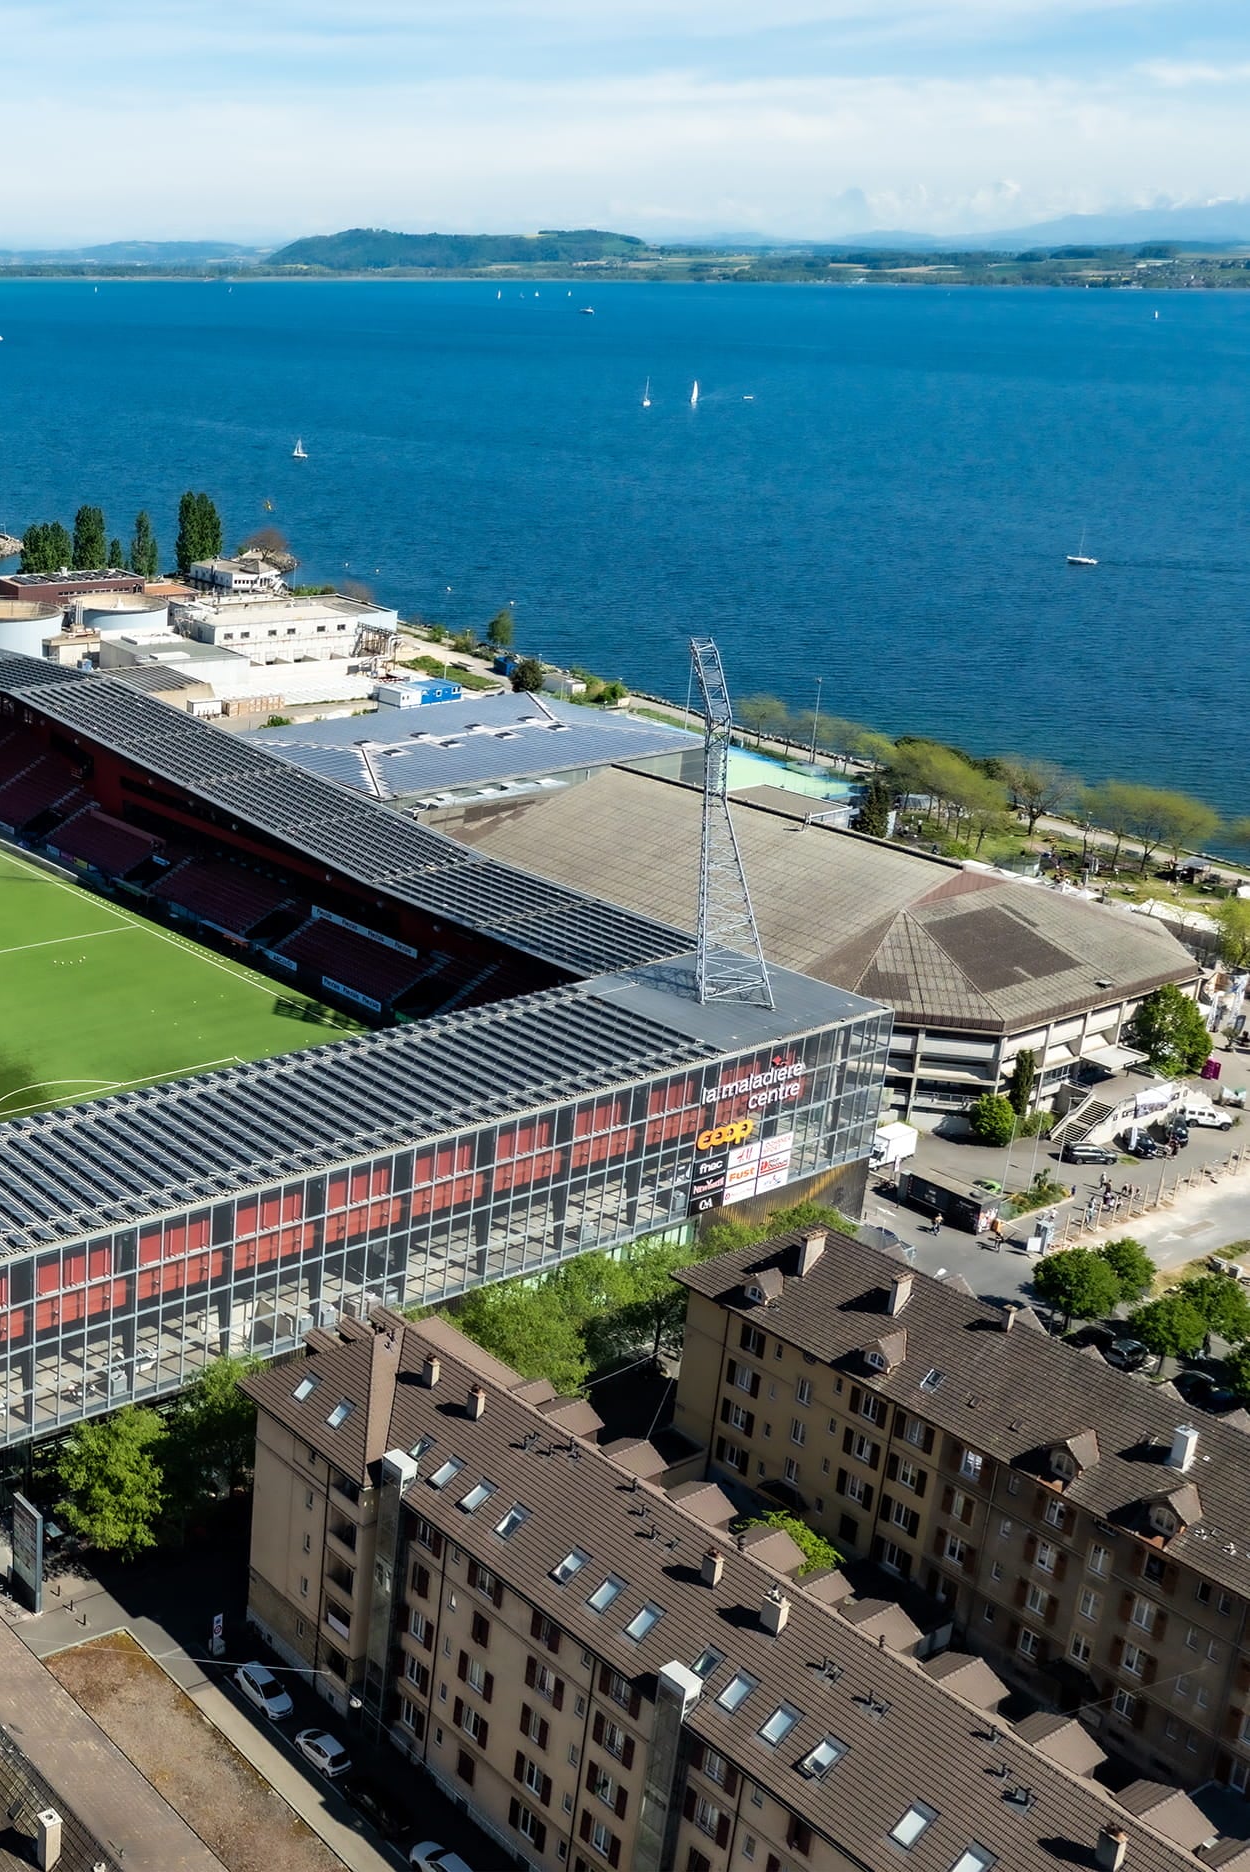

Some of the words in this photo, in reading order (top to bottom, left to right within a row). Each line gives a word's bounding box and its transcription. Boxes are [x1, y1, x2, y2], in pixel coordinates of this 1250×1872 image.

[702, 1086, 719, 1105] la
[748, 1081, 800, 1109] centre
[697, 1119, 753, 1150] coop
[699, 1160, 723, 1174] fnac
